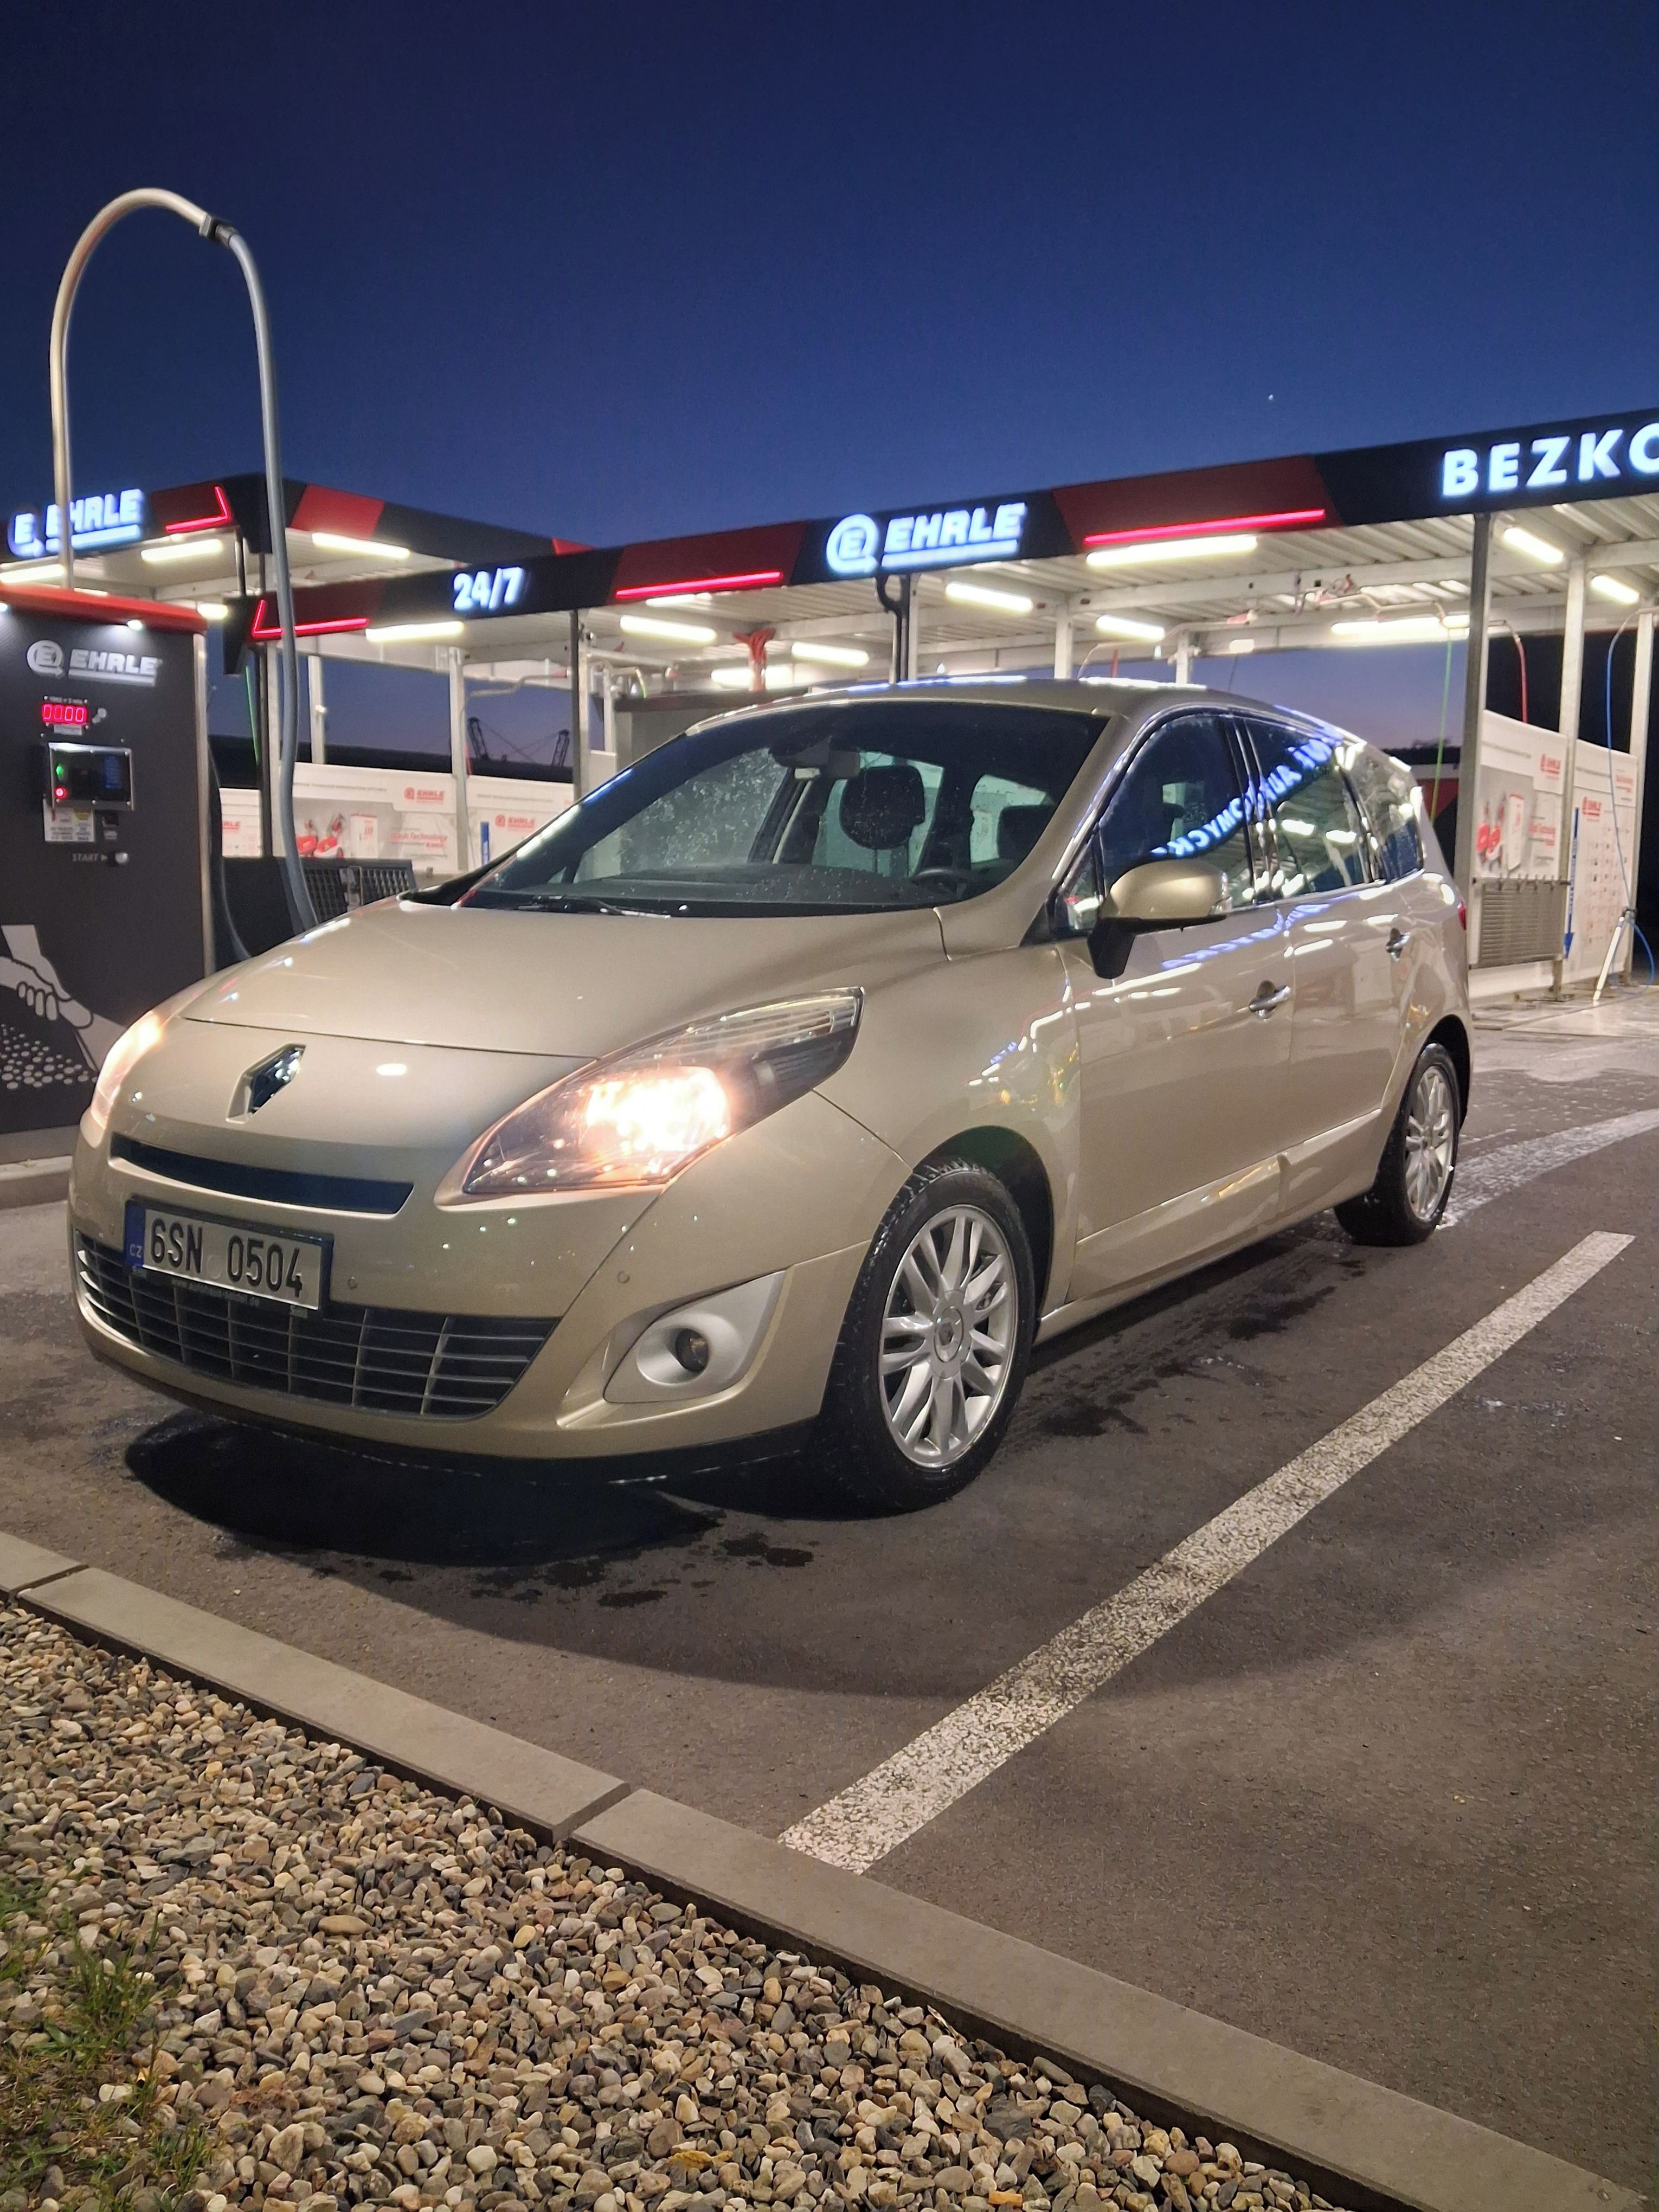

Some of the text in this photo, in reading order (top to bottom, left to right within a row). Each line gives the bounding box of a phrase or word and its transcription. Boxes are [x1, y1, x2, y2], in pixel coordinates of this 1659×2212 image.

[1443, 422, 1659, 497] BEZKO
[884, 502, 1026, 553] EHRLE
[453, 566, 524, 610] 24/7
[70, 648, 159, 676] EHRLE
[43, 704, 85, 723] 0000
[150, 1218, 203, 1275] 6SN
[227, 1235, 304, 1298] 0504
